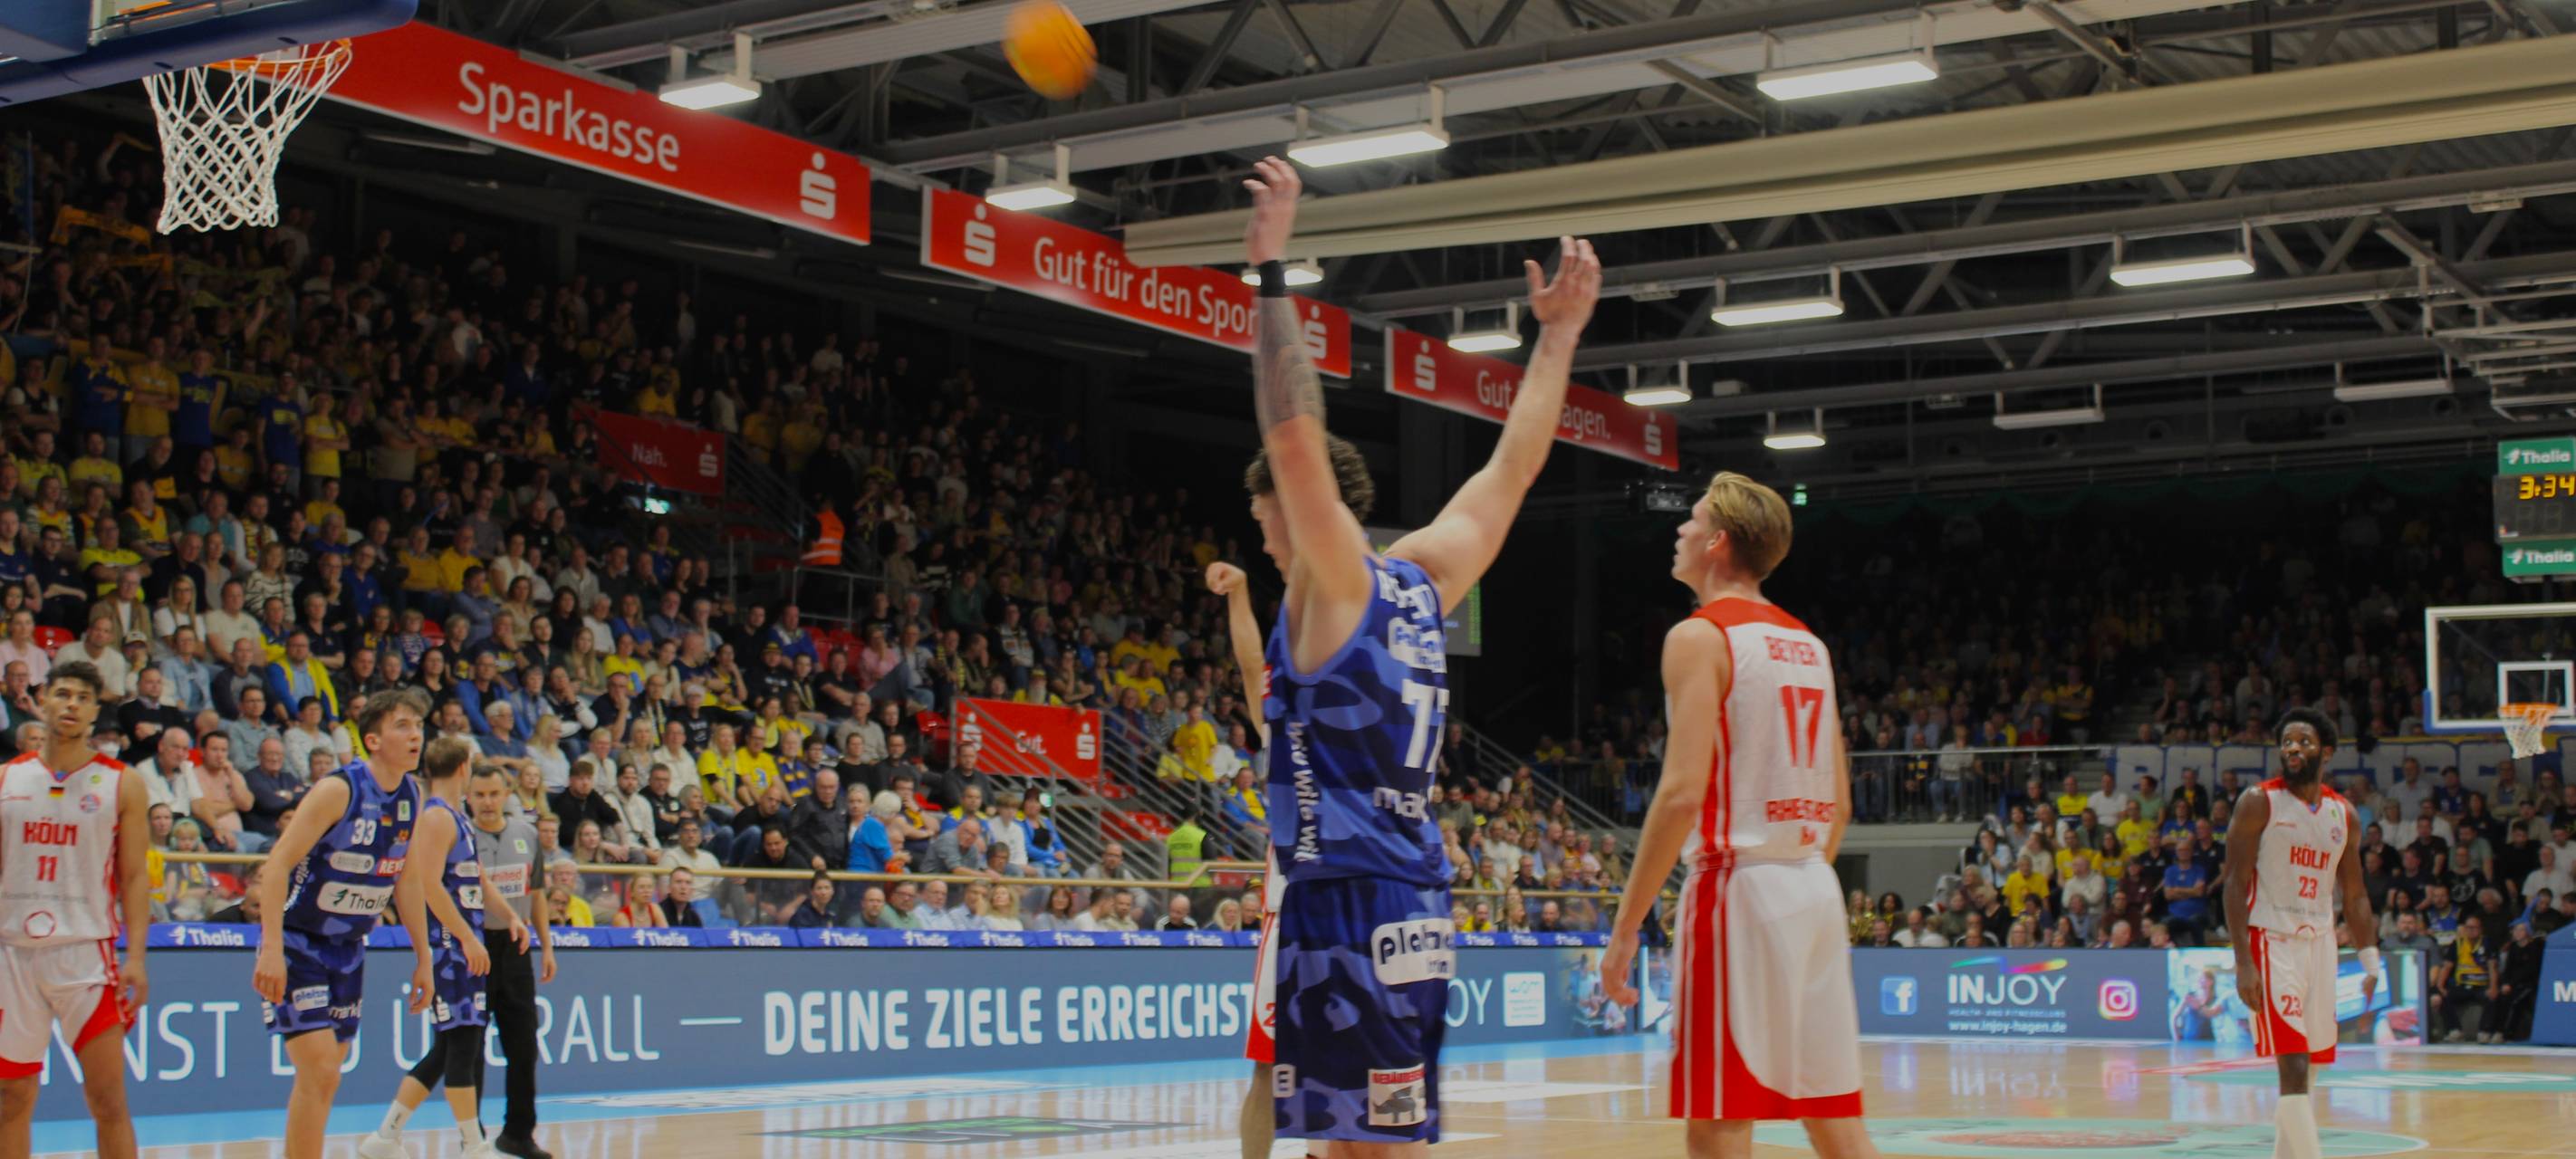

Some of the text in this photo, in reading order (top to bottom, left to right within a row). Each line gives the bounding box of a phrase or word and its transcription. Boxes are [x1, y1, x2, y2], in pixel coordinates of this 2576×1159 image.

[458, 62, 679, 172] Sparkasse
[1034, 236, 1250, 337] Gut für den Spor
[1477, 370, 1611, 440] Gut agen.
[632, 443, 667, 467] Nah.
[2522, 449, 2571, 464] Thalia
[2524, 550, 2575, 563] Thalia
[1779, 685, 1825, 768] 17
[23, 817, 78, 846] KÖLN
[351, 818, 377, 846] 33
[37, 856, 58, 881] 11
[379, 858, 406, 874] REW
[2290, 844, 2330, 870] KÖLN
[2299, 876, 2319, 899] 23
[190, 928, 245, 946] Thalia
[647, 931, 688, 946] Thalia
[739, 932, 781, 946] Thalia
[830, 933, 869, 947] Thalia
[1948, 974, 2067, 1006] INJOY
[764, 982, 1254, 1055] DEINE ZIELE ERREICHST
[1948, 1020, 2068, 1035] www.injoy-hagen.de
